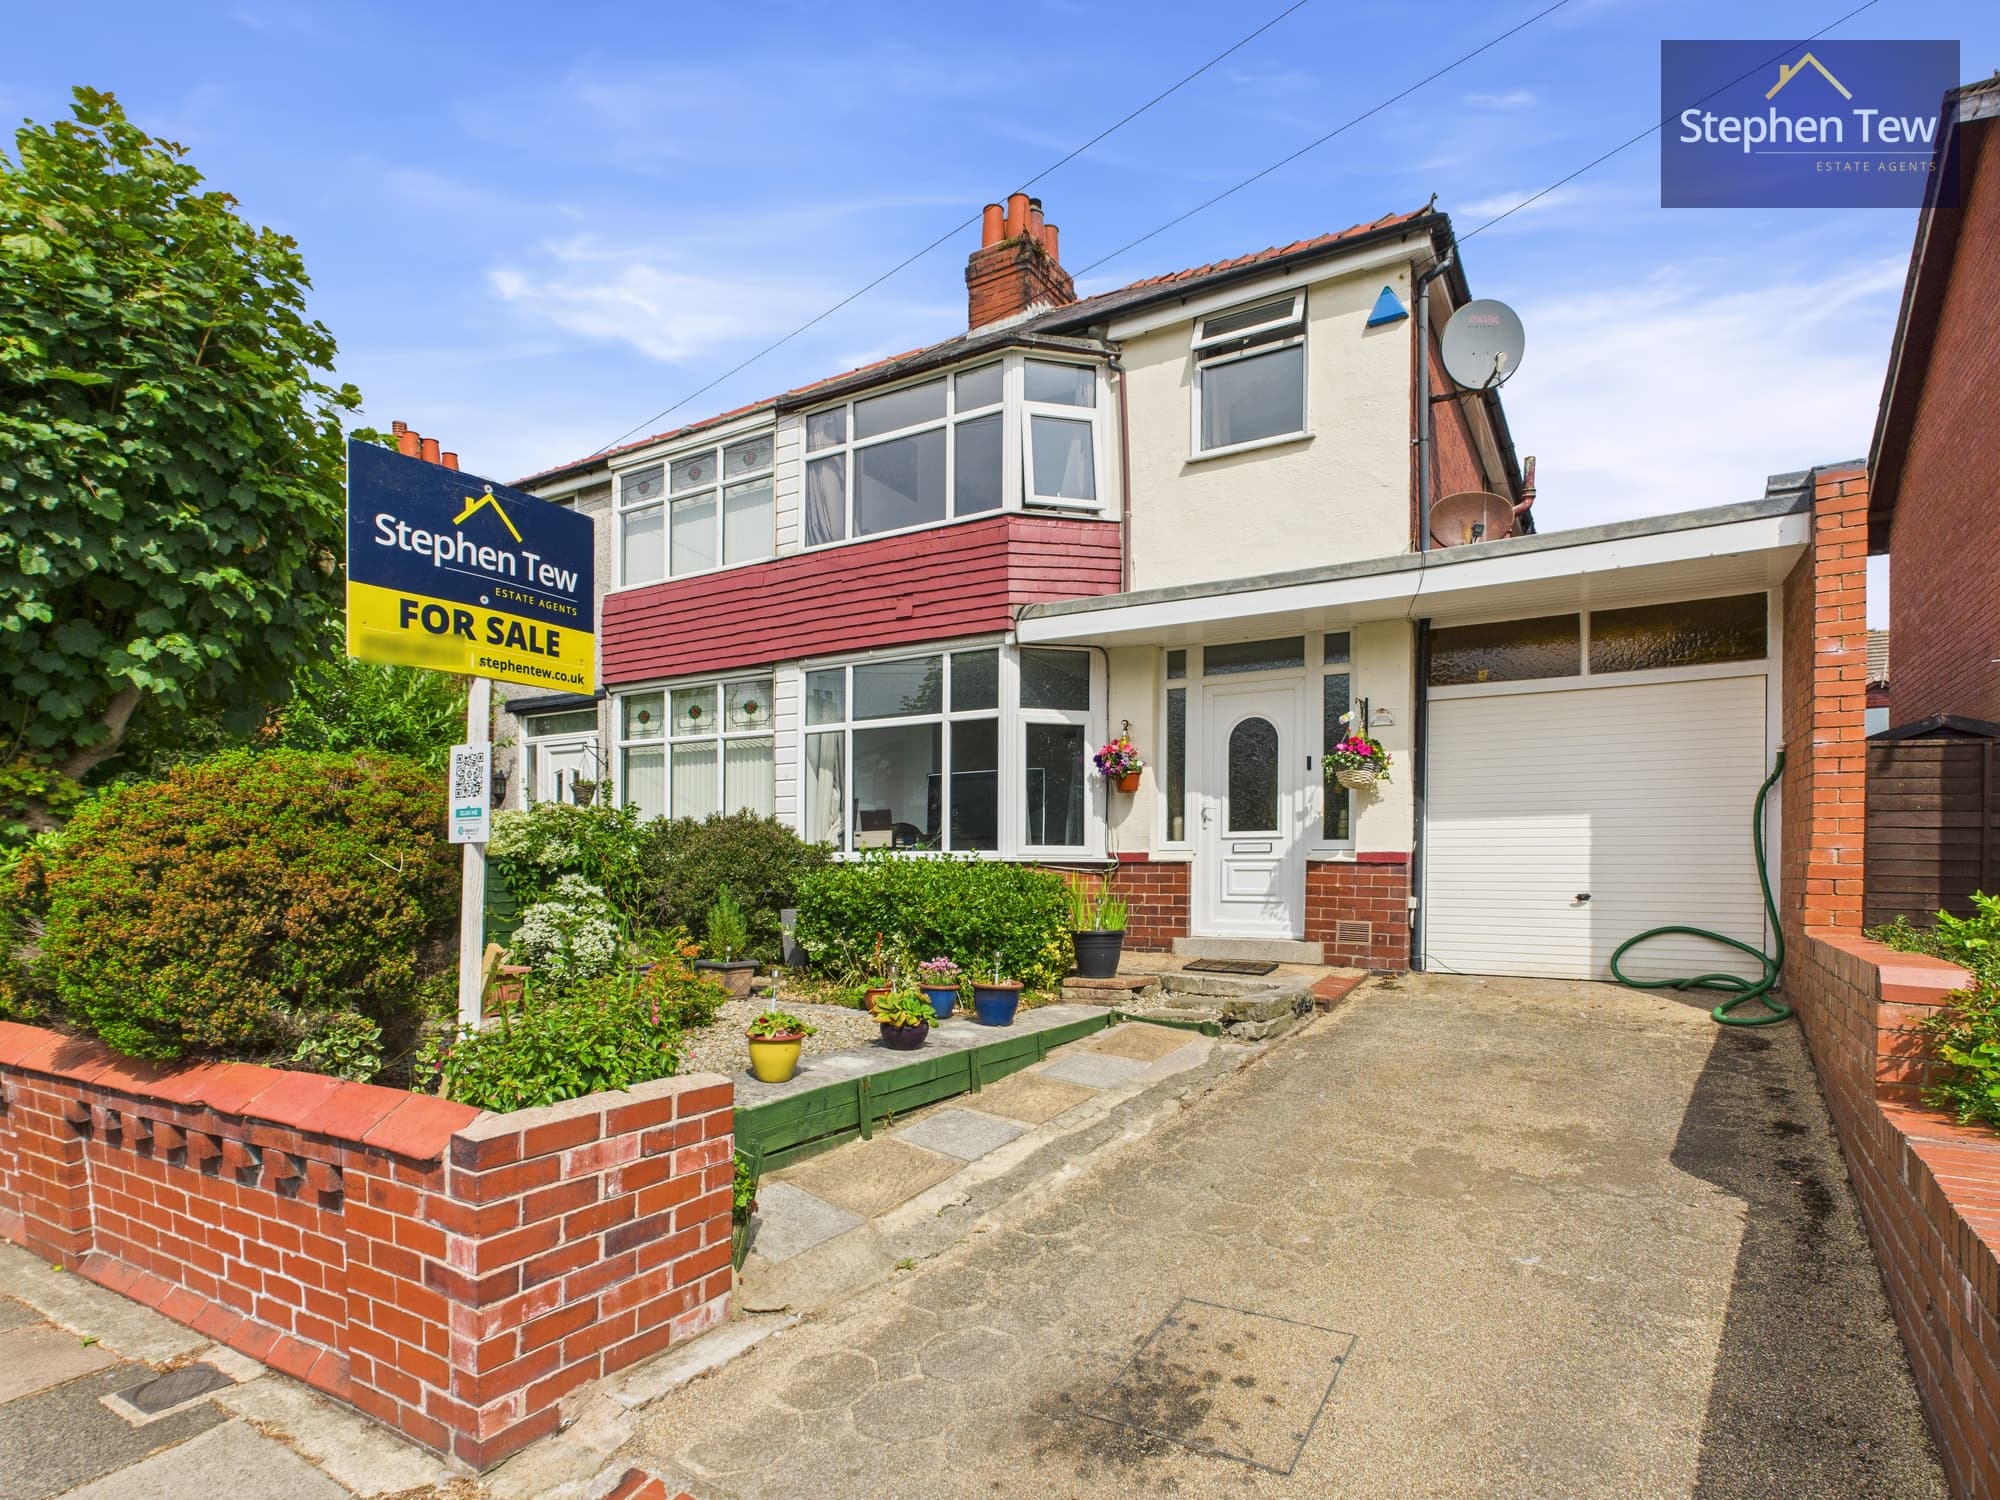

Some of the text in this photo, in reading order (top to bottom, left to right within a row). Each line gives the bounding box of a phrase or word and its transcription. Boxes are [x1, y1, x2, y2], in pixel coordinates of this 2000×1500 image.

[375, 513, 578, 593] Stephen Tew
[495, 587, 577, 616] ESTATE AGENTS
[400, 598, 477, 641] FOR
[486, 616, 560, 658] SALE
[479, 656, 585, 685] stephentew.co.uk
